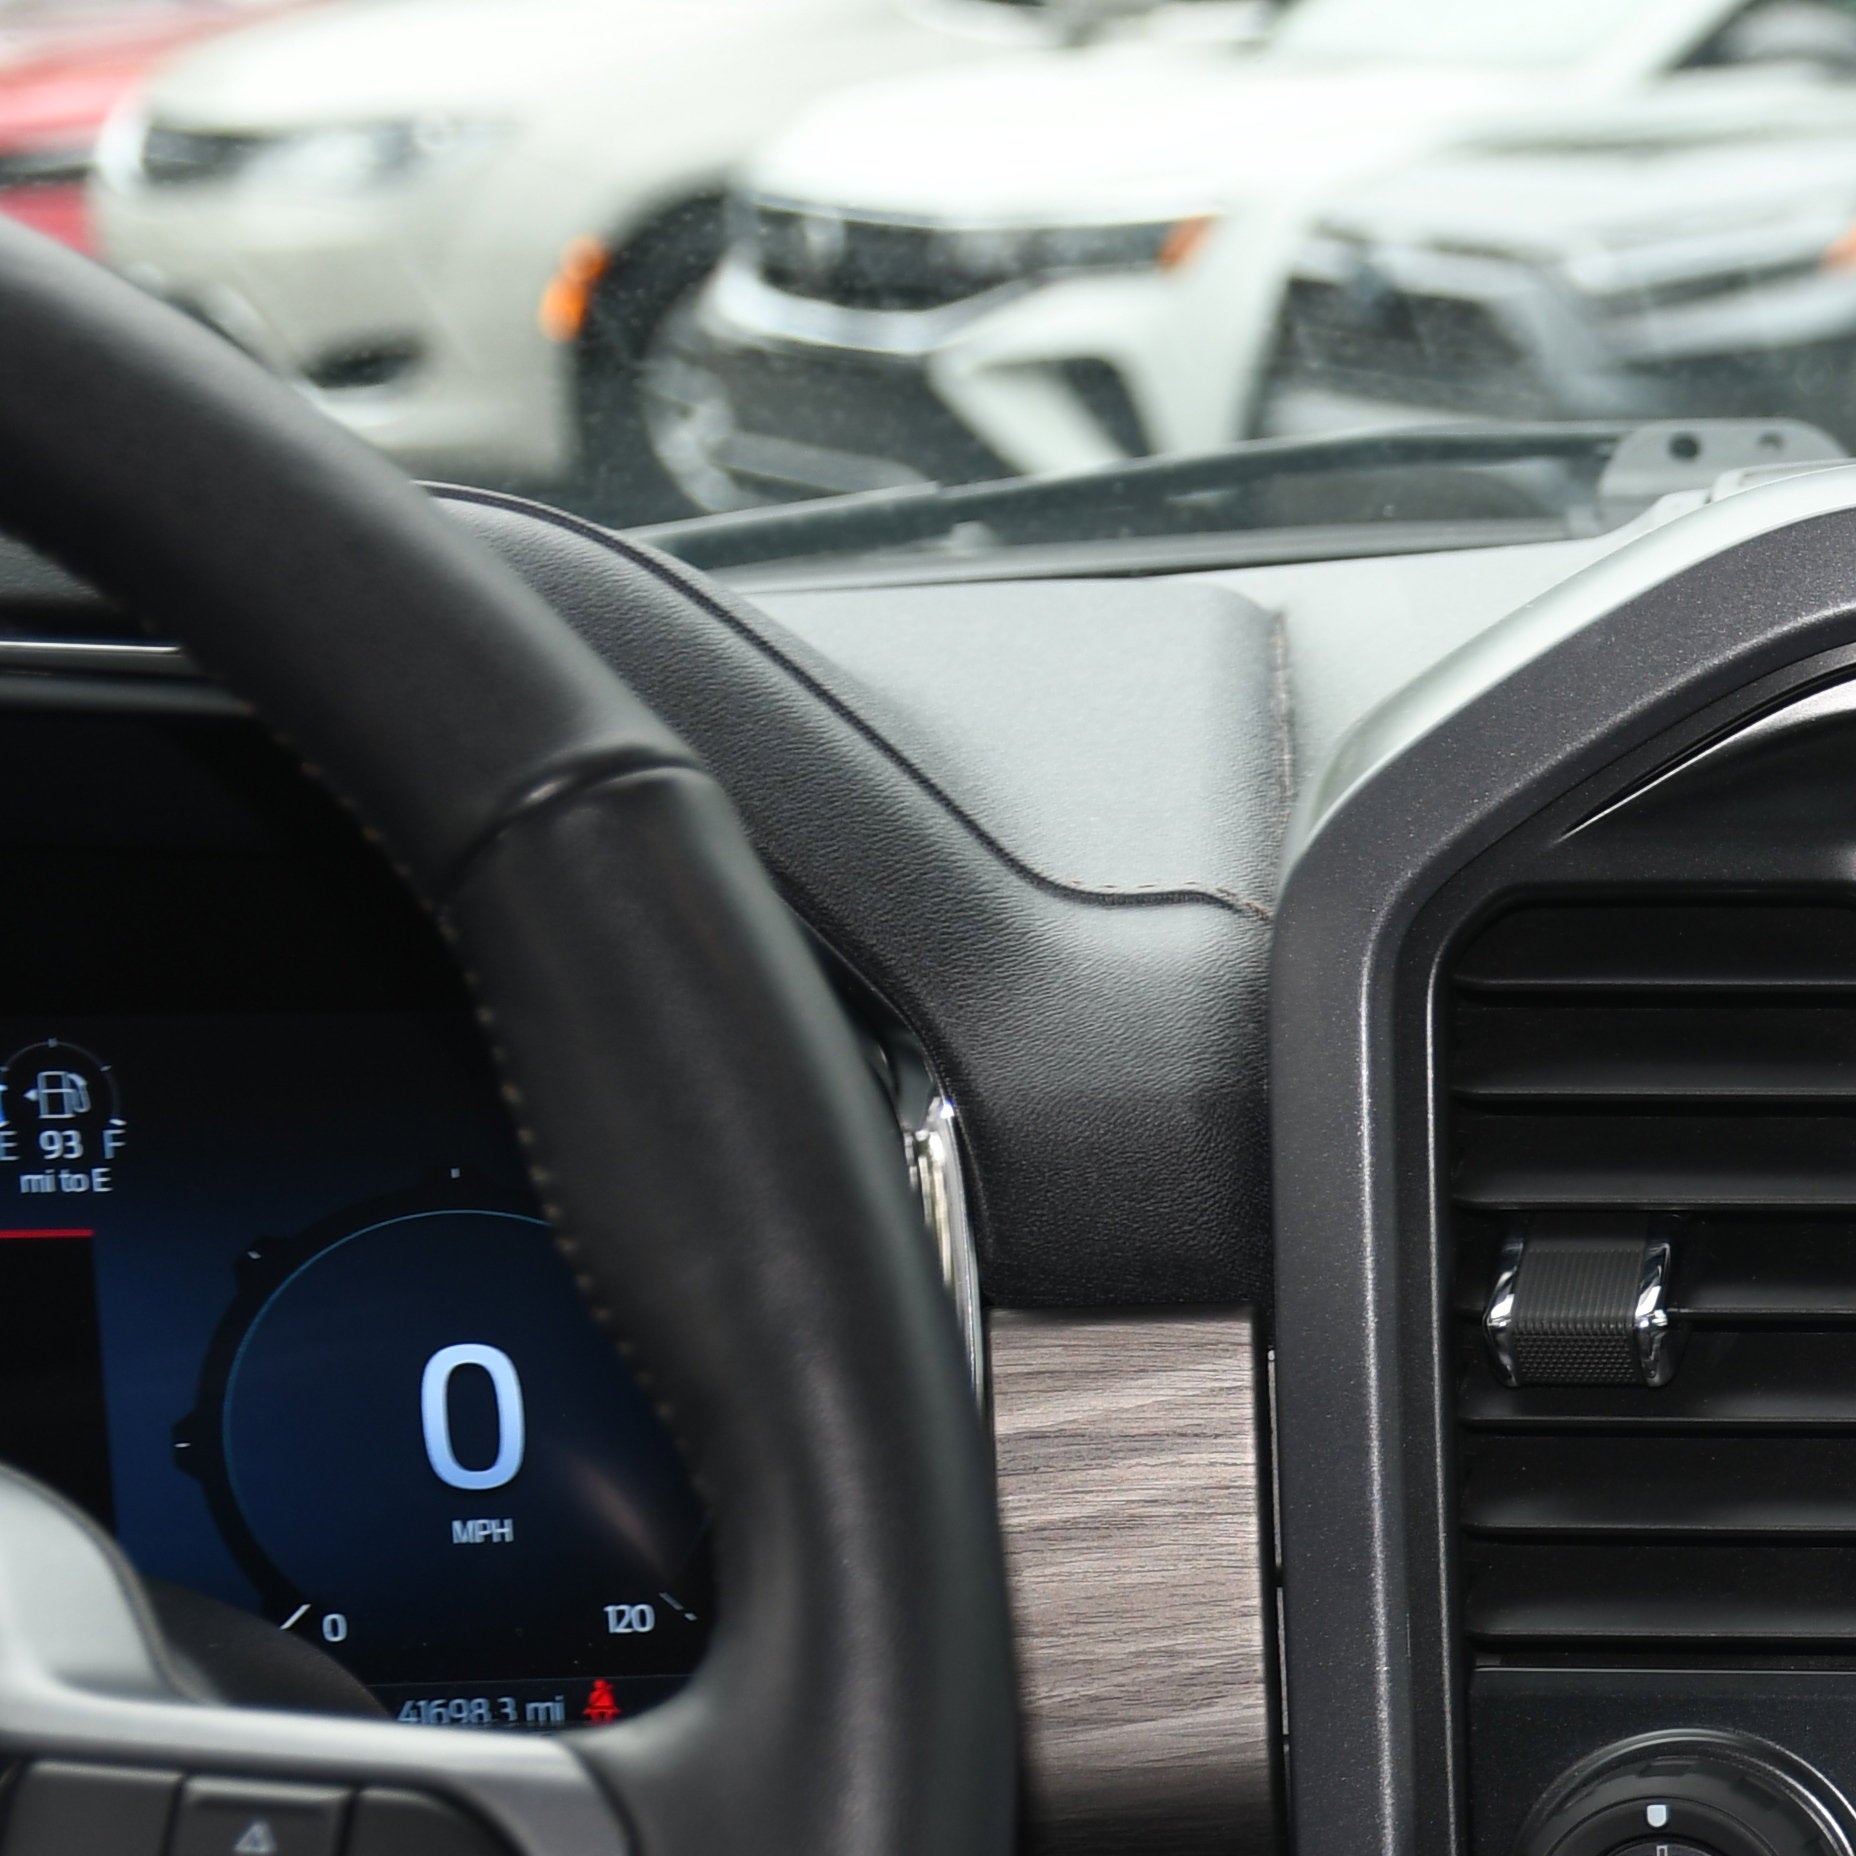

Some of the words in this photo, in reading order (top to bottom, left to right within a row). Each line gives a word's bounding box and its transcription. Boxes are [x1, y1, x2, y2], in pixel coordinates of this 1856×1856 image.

[38, 1130, 84, 1160] 93
[102, 1129, 126, 1159] F
[20, 1169, 56, 1193] mi
[59, 1169, 89, 1192] to
[92, 1168, 112, 1192] E
[420, 1342, 525, 1490] 0
[452, 1519, 513, 1543] MPH
[322, 1616, 347, 1642] 0
[604, 1605, 655, 1633] 120
[525, 1694, 565, 1726] mi
